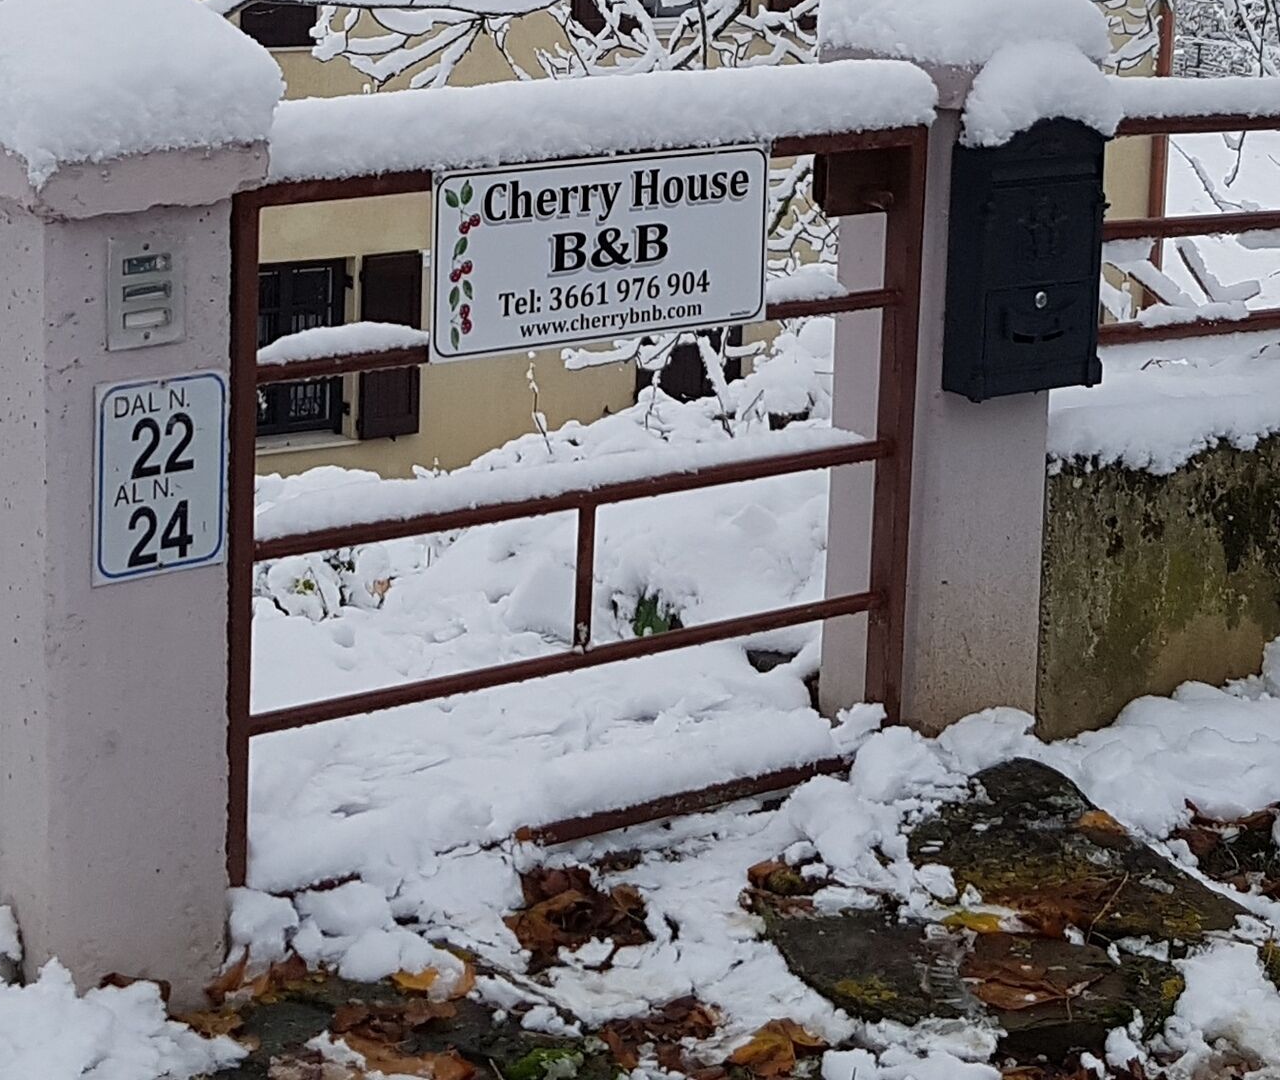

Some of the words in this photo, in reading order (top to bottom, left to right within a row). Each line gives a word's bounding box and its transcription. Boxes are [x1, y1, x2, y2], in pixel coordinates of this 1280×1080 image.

[483, 180, 622, 222] Cherry
[632, 169, 749, 208] House
[551, 223, 669, 272] B&B
[498, 289, 542, 317] Tel:
[549, 281, 609, 311] 3661
[617, 275, 661, 302] 976
[667, 269, 710, 296] 904
[520, 303, 702, 338] www.cherrybnb.com
[114, 392, 161, 419] DAL
[170, 387, 191, 409] N.
[131, 412, 195, 480] 22
[114, 482, 144, 507] AL
[153, 477, 175, 500] N.
[127, 500, 194, 568] 24
